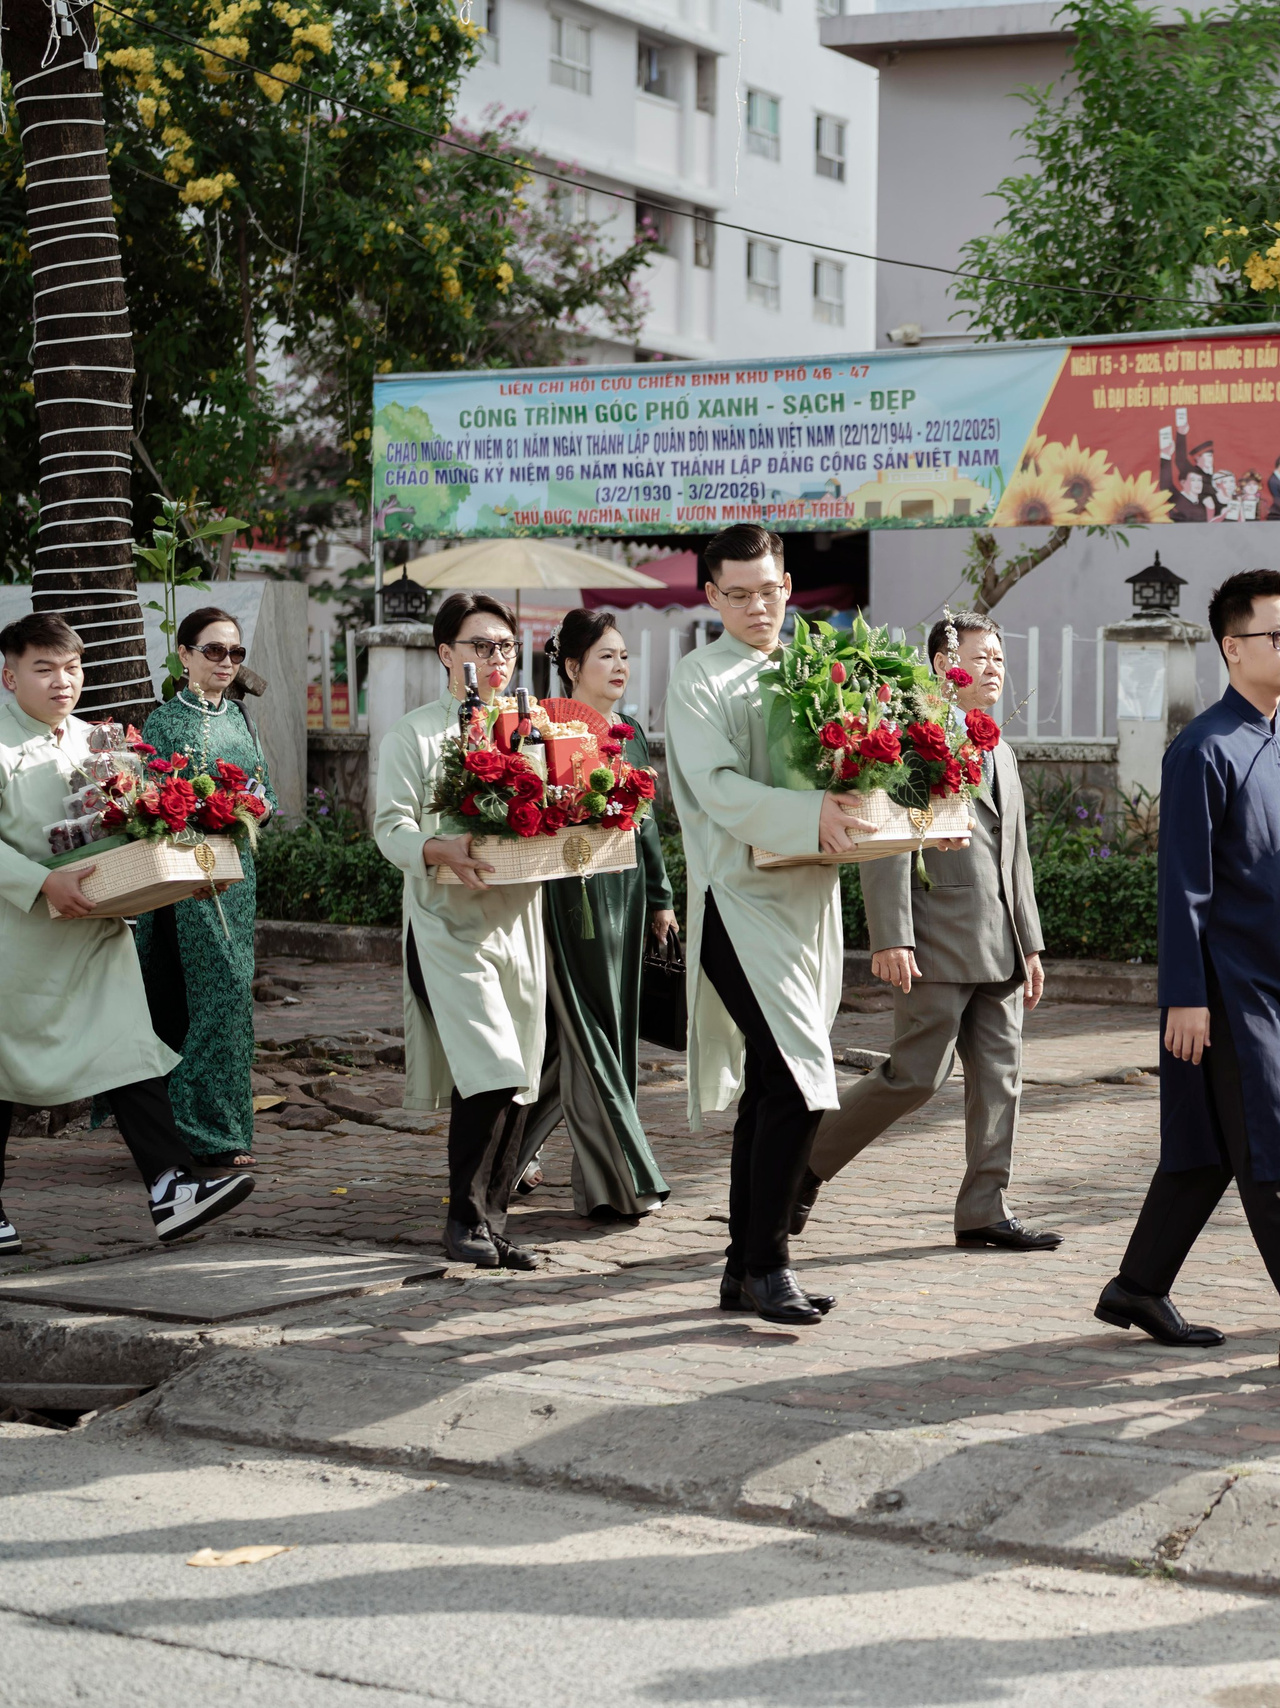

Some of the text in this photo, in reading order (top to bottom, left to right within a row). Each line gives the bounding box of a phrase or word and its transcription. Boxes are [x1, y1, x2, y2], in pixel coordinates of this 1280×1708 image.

[499, 382, 533, 396] LIÊN
[538, 381, 564, 393] CHI
[569, 378, 595, 396] HỘI
[601, 377, 632, 394] CỰU
[638, 371, 686, 389] CHIẾN
[691, 372, 730, 387] BINH
[735, 370, 768, 385] KHU
[774, 365, 806, 382] PHỐ
[812, 367, 832, 381] 46
[850, 365, 870, 378] 47
[459, 405, 517, 429] CÔNG
[524, 402, 588, 426] TRÌNH
[595, 398, 638, 423] GÓC
[646, 393, 690, 421] PHỐ
[697, 396, 758, 418] XANH
[783, 393, 845, 419] SẠCH
[870, 389, 917, 415] ĐẸP
[386, 438, 418, 463] CHÀO
[421, 437, 453, 462] MỪNG
[457, 433, 471, 461] KỶ
[474, 436, 503, 464] NIỆM
[506, 439, 519, 459] 81
[523, 433, 549, 458] NĂM
[553, 432, 583, 457] NGÀY
[587, 431, 624, 456] THÀNH
[628, 427, 649, 459] LẬP
[654, 427, 685, 455] QUÂN
[689, 426, 709, 456] ĐỘI
[712, 425, 745, 451] NHÂN
[750, 423, 774, 450] DÂN
[777, 422, 802, 453] VIỆT
[807, 425, 835, 448] NAM
[839, 421, 913, 448] (22/12/1944
[926, 418, 1000, 442] 22/12/2025)
[385, 447, 999, 486] CHÀO MỪNG KỶ NIỆM 96 NĂM NGÀY THÀNH LẬP ĐẢNG CỘNG SẢN VIỆT NAM
[596, 484, 671, 504] (3/2/1930
[688, 481, 766, 500] 3/2/2026)
[513, 505, 539, 526] THỦ
[544, 507, 572, 525] ĐỨC
[577, 505, 622, 524] NGHĨA
[627, 504, 661, 522] TÌNH
[677, 505, 717, 521] VƯƠN
[722, 501, 762, 520] MÌNH
[767, 500, 804, 519] PHÁT
[811, 499, 855, 518] TRIỂN
